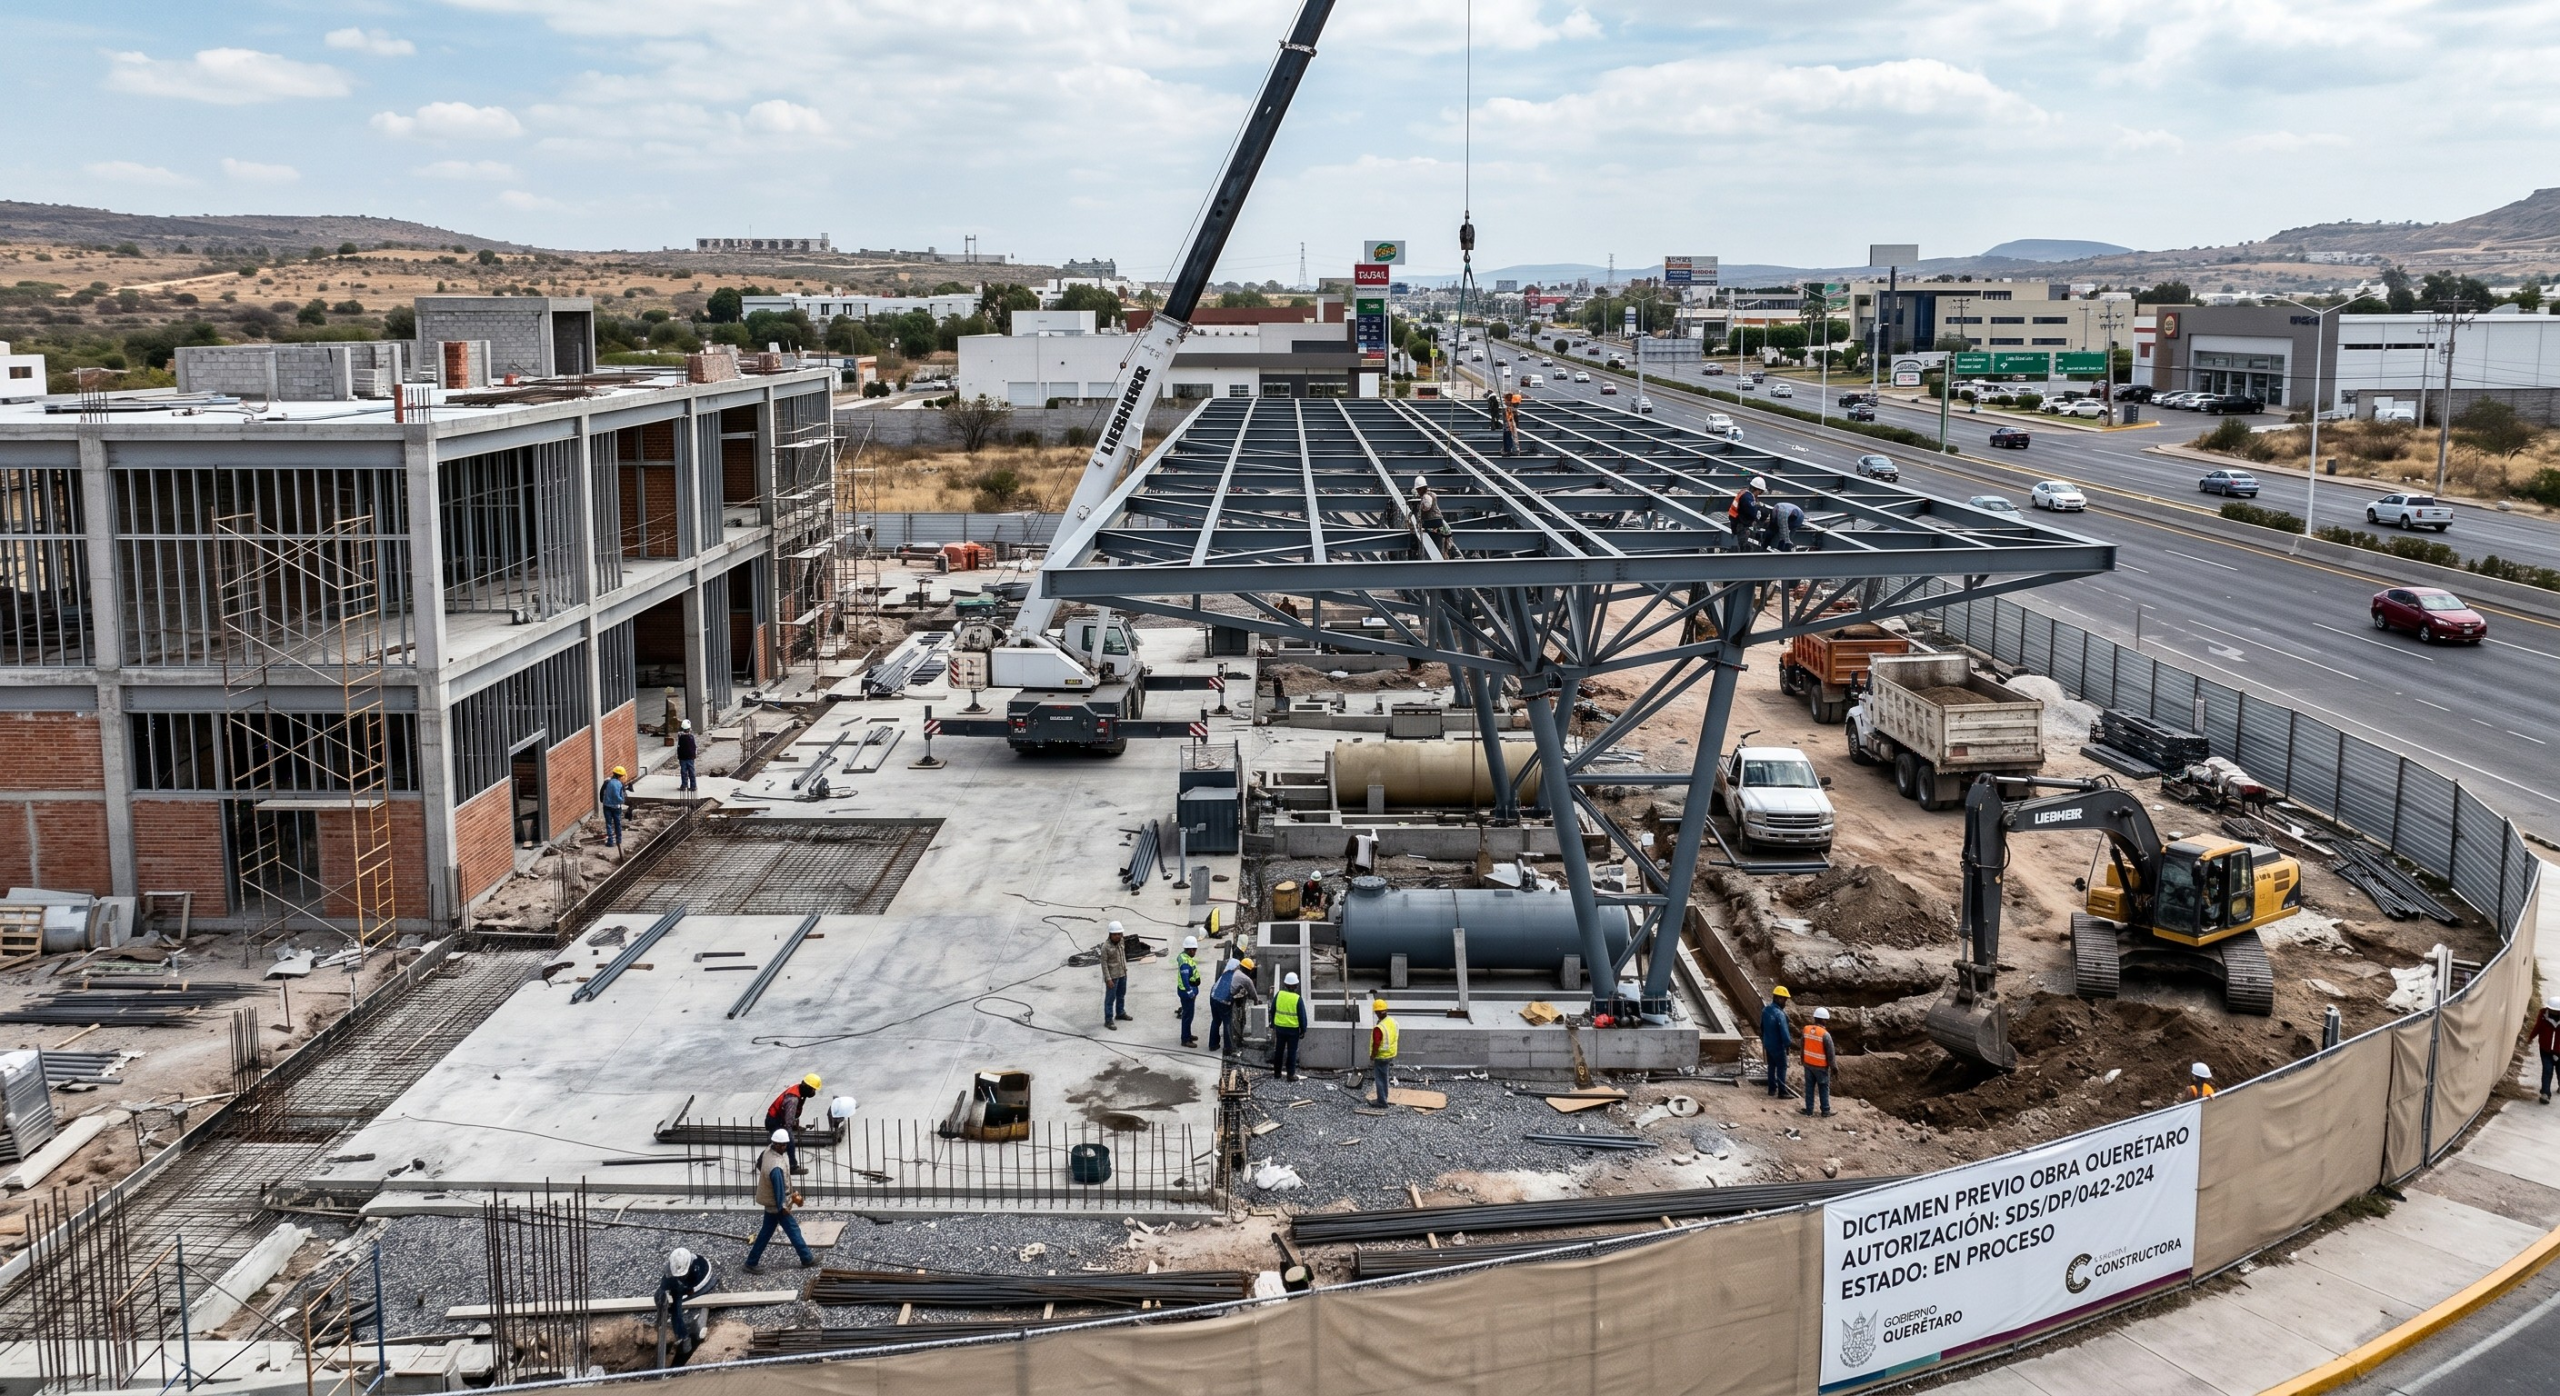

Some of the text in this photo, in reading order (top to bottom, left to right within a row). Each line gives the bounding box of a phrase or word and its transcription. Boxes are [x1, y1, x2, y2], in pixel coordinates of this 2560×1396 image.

[1841, 1164, 2155, 1271] AUTORIZACIÓN: SDS/DP/042-2024
[1843, 1126, 2190, 1240] DICTAMEN PREVIO OBRA QUERÉTARO
[1841, 1262, 1928, 1301] ESTADO:
[1934, 1250, 1961, 1276] EN
[1966, 1223, 2055, 1266] PROCESO
[2094, 1238, 2182, 1277] CONSTRUCTORA
[1884, 1304, 1938, 1328] GOBIERNO
